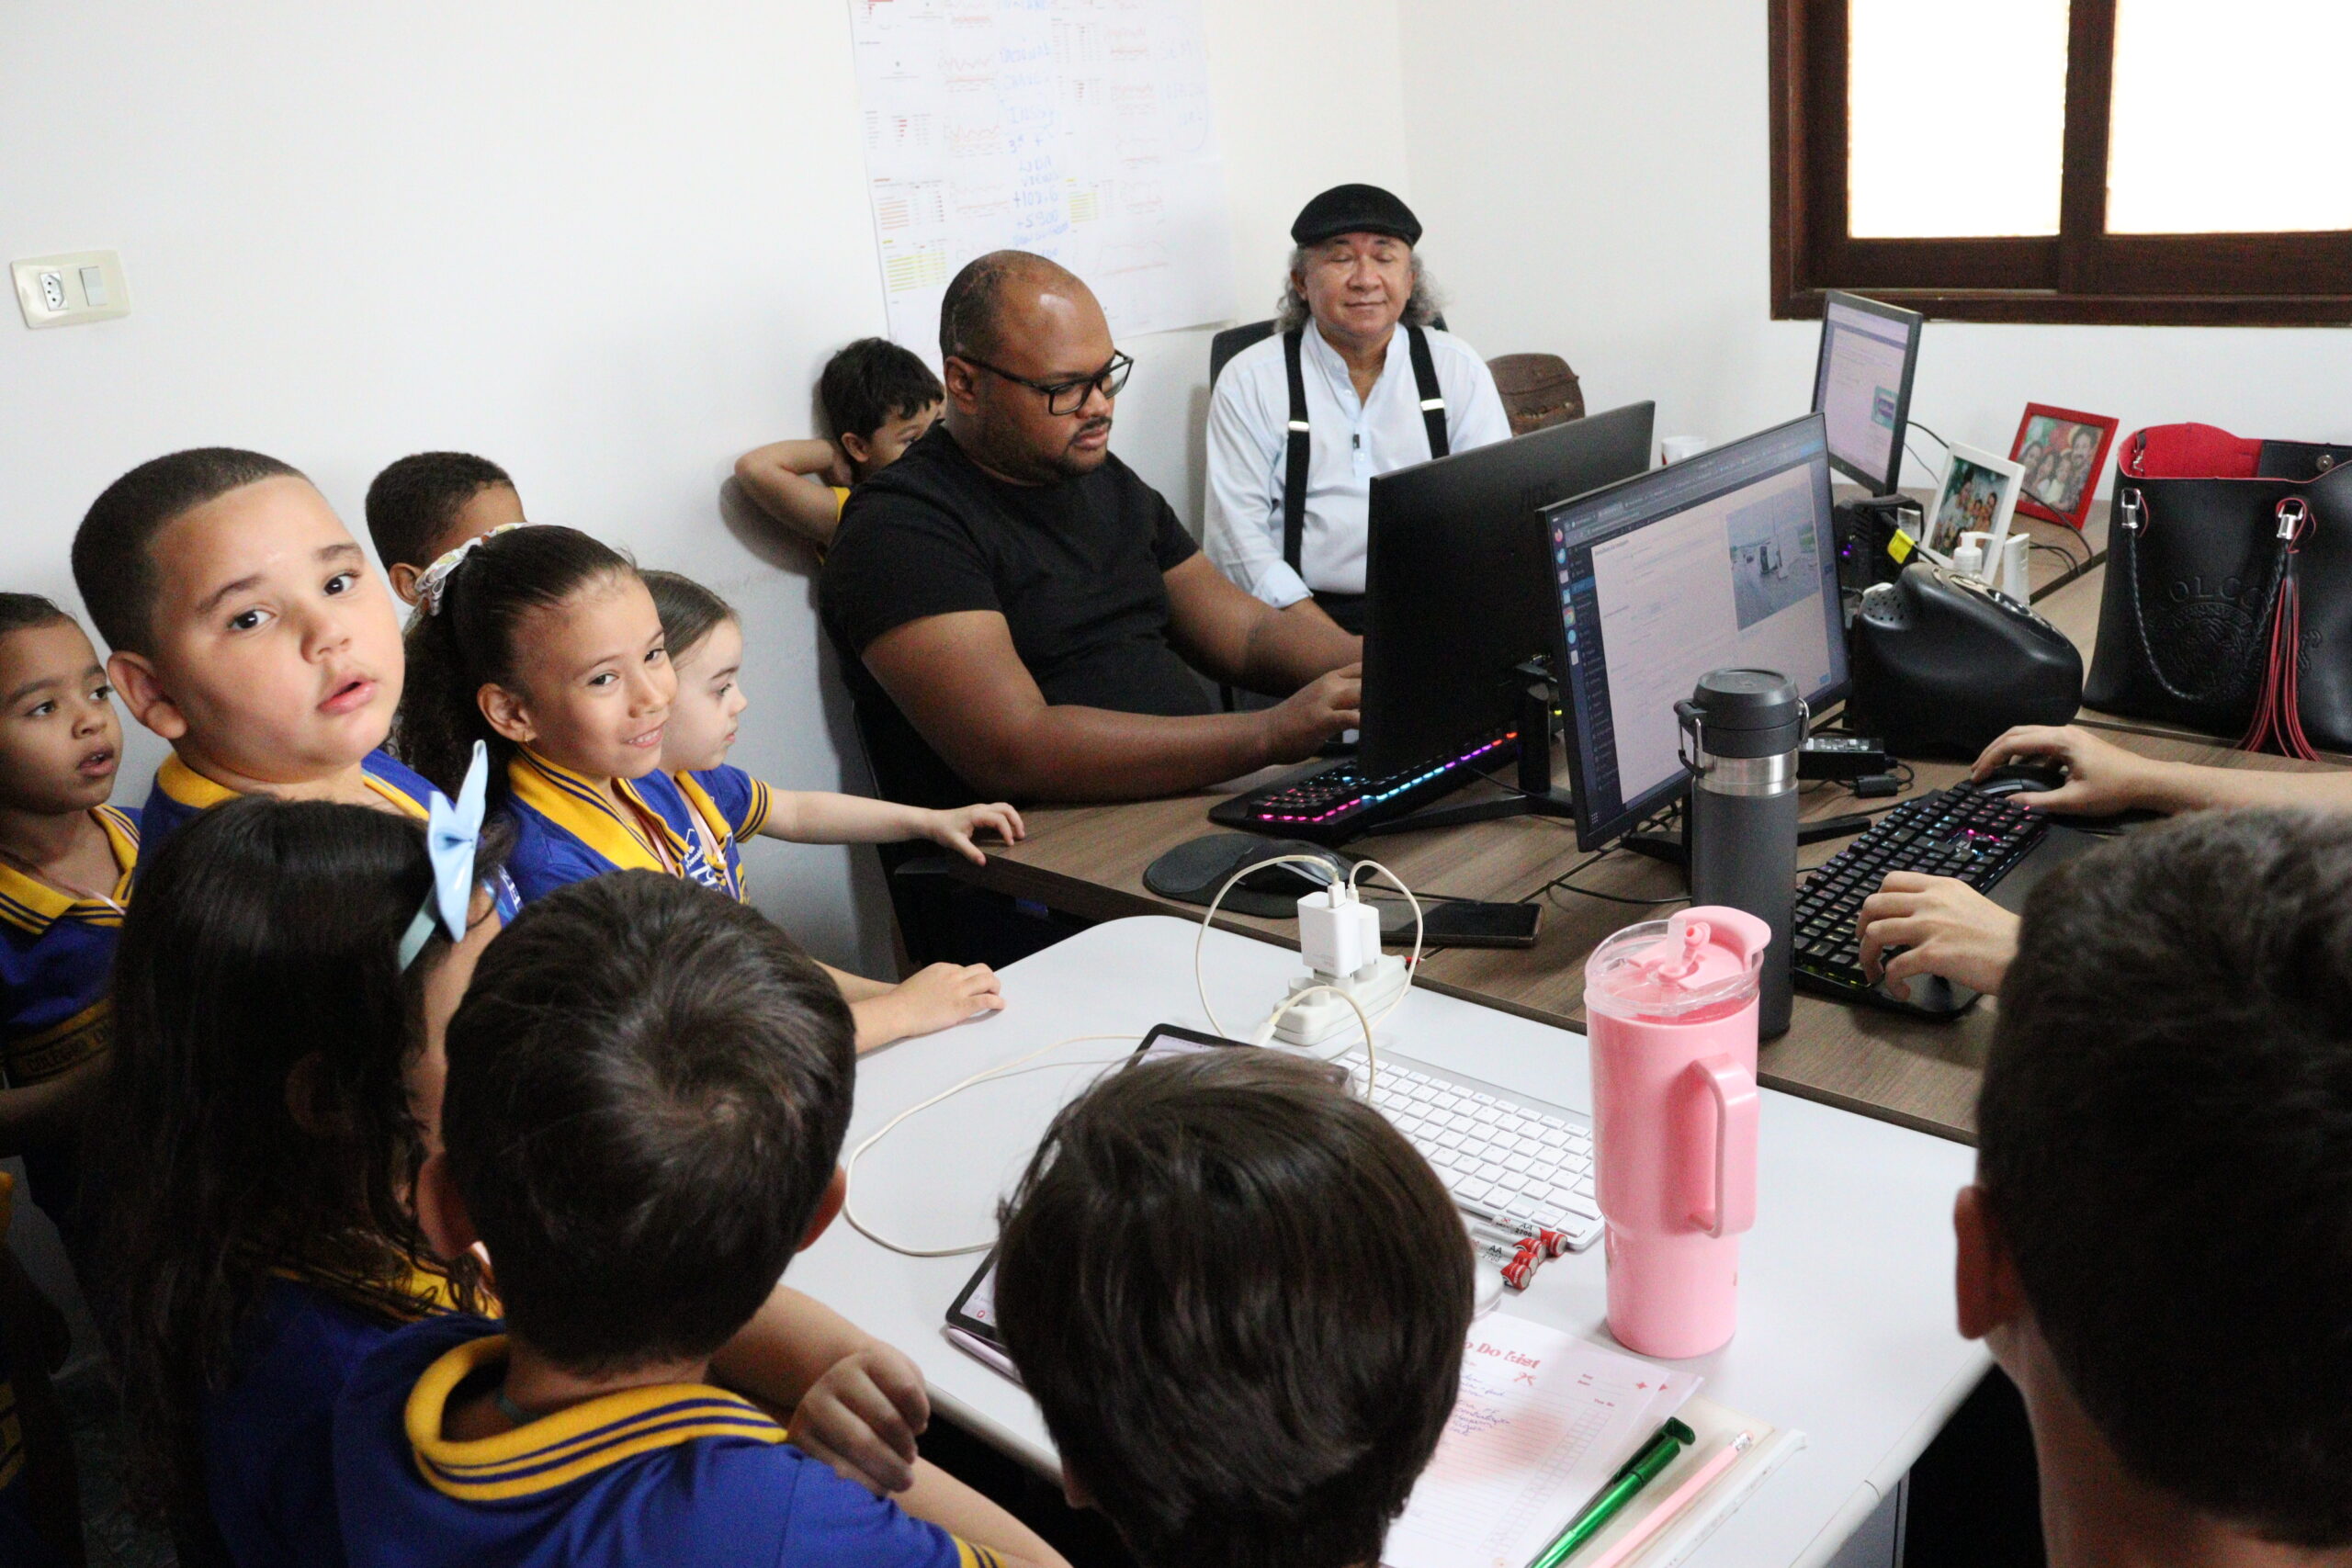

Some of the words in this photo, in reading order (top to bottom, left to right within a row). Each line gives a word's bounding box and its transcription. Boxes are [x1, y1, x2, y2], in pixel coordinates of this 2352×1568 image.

[1515, 1227, 1532, 1237] 2700
[1488, 1245, 1502, 1255] AA
[1476, 1342, 1501, 1358] Do
[1503, 1350, 1541, 1370] List
